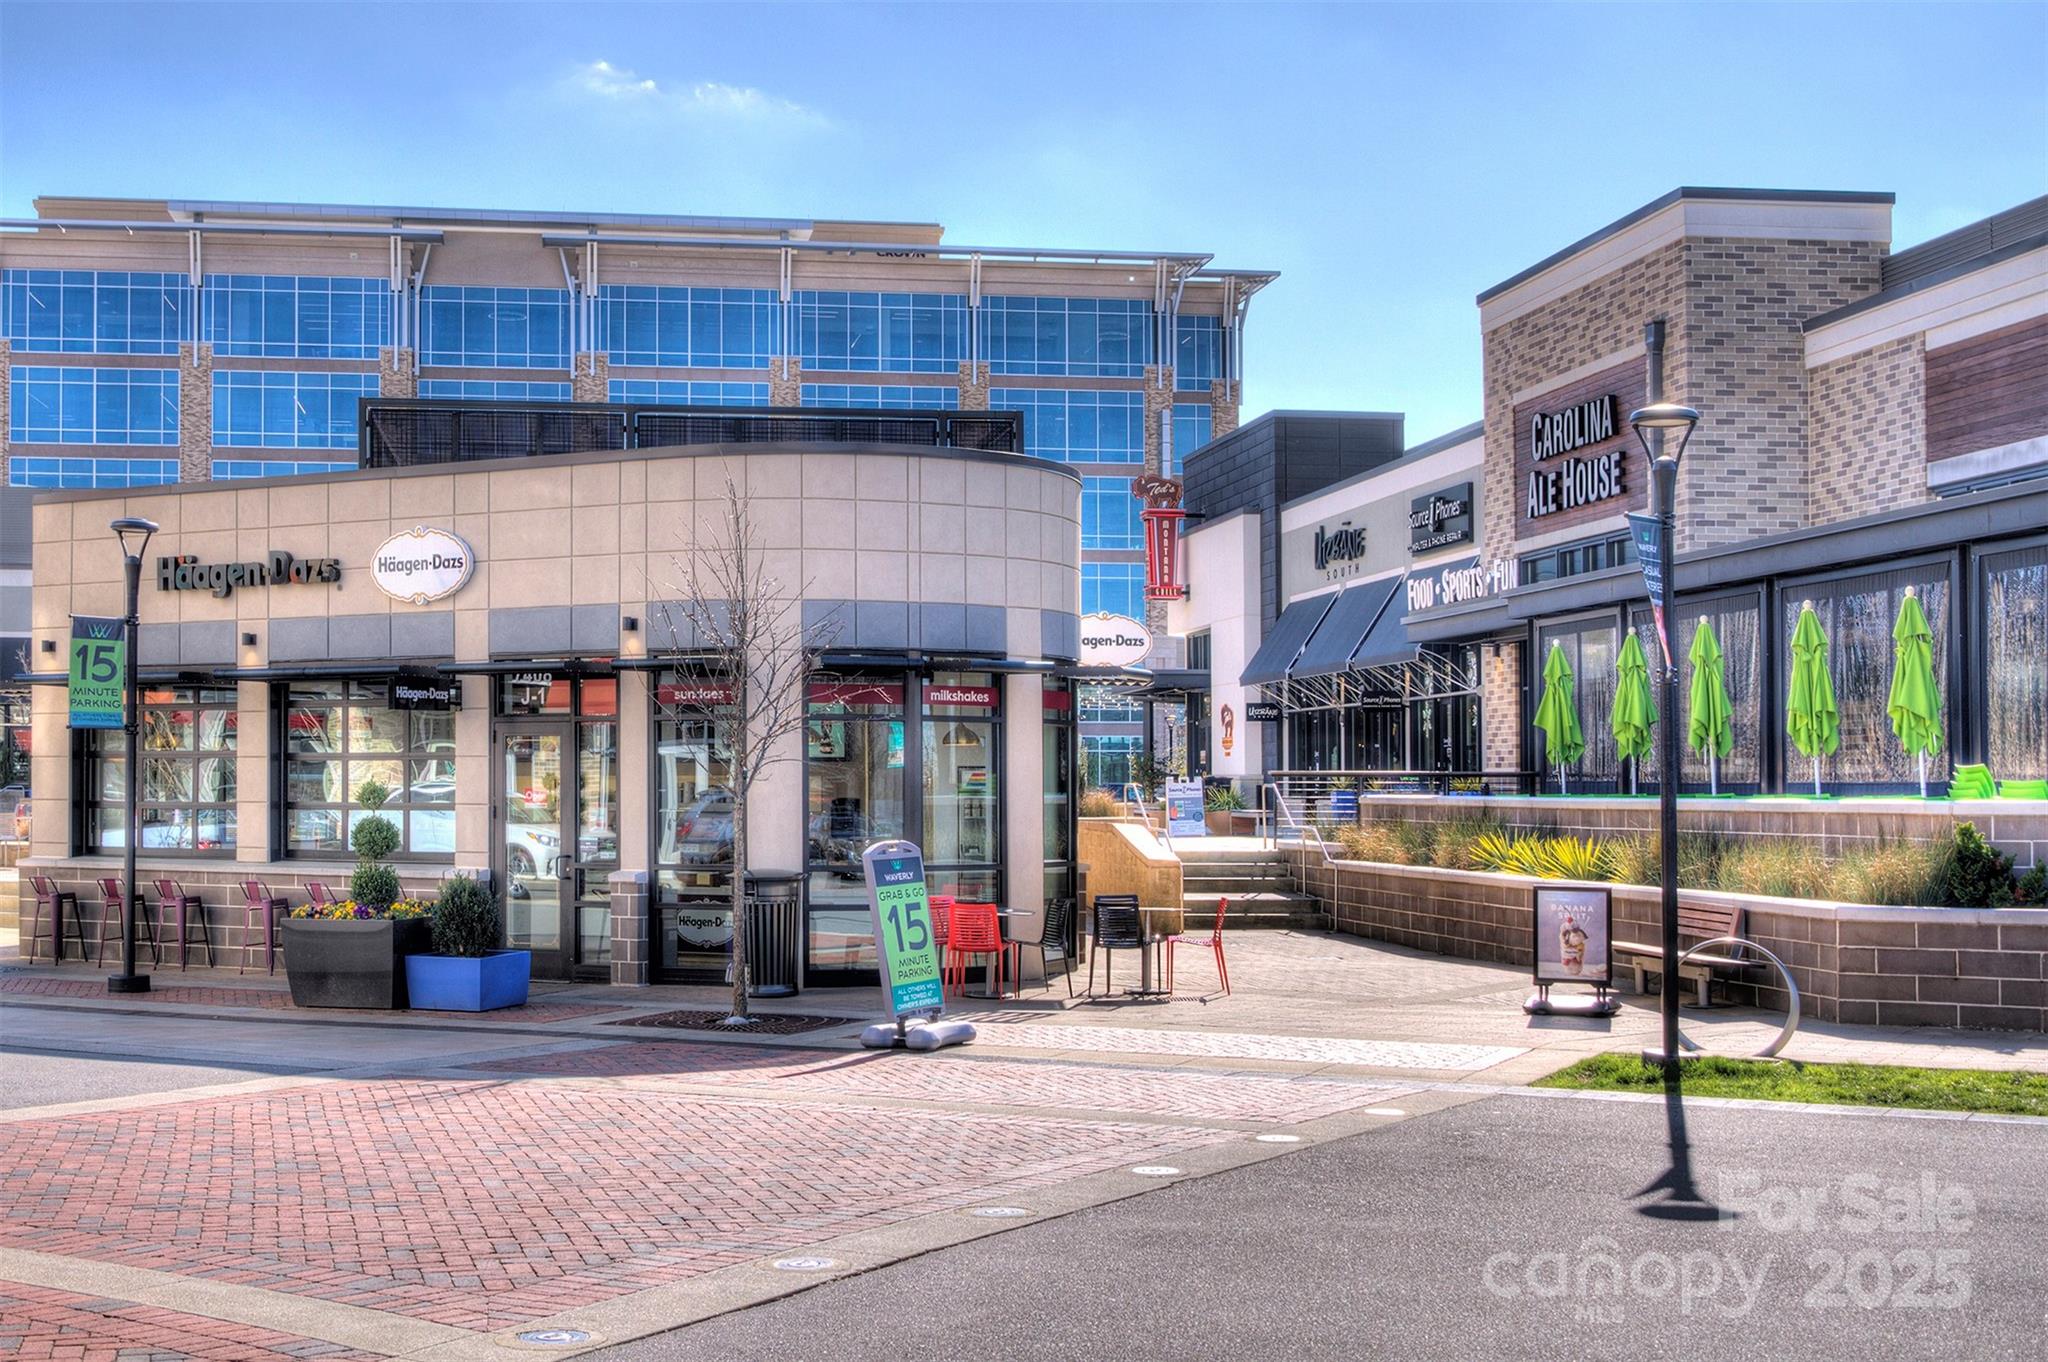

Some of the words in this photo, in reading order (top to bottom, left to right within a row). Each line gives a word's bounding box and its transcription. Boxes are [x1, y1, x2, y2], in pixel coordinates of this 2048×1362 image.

[1532, 395, 1617, 461] CAROLINA
[1147, 483, 1175, 496] Ted's
[1527, 472, 1561, 519] ALE
[1562, 452, 1625, 509] HOUSE
[1408, 510, 1429, 529] Source
[1435, 499, 1460, 521] Phones
[1327, 563, 1360, 581] SOUTH
[1407, 577, 1434, 611] FOOD
[1441, 568, 1484, 605] SPORTS
[1493, 559, 1519, 593] FUN
[75, 644, 118, 683] 15
[73, 687, 119, 697] MINUTE
[521, 687, 545, 705] J-1
[930, 690, 990, 703] milkshakes
[70, 698, 121, 709] PARKING
[884, 871, 914, 881] WAVERLY
[879, 889, 903, 901] GRAB
[905, 889, 911, 898] &
[912, 887, 925, 897] GO
[1550, 904, 1594, 913] BANANA
[887, 901, 928, 952] 15
[898, 954, 930, 968] MINUTE
[897, 965, 933, 980] PARKING
